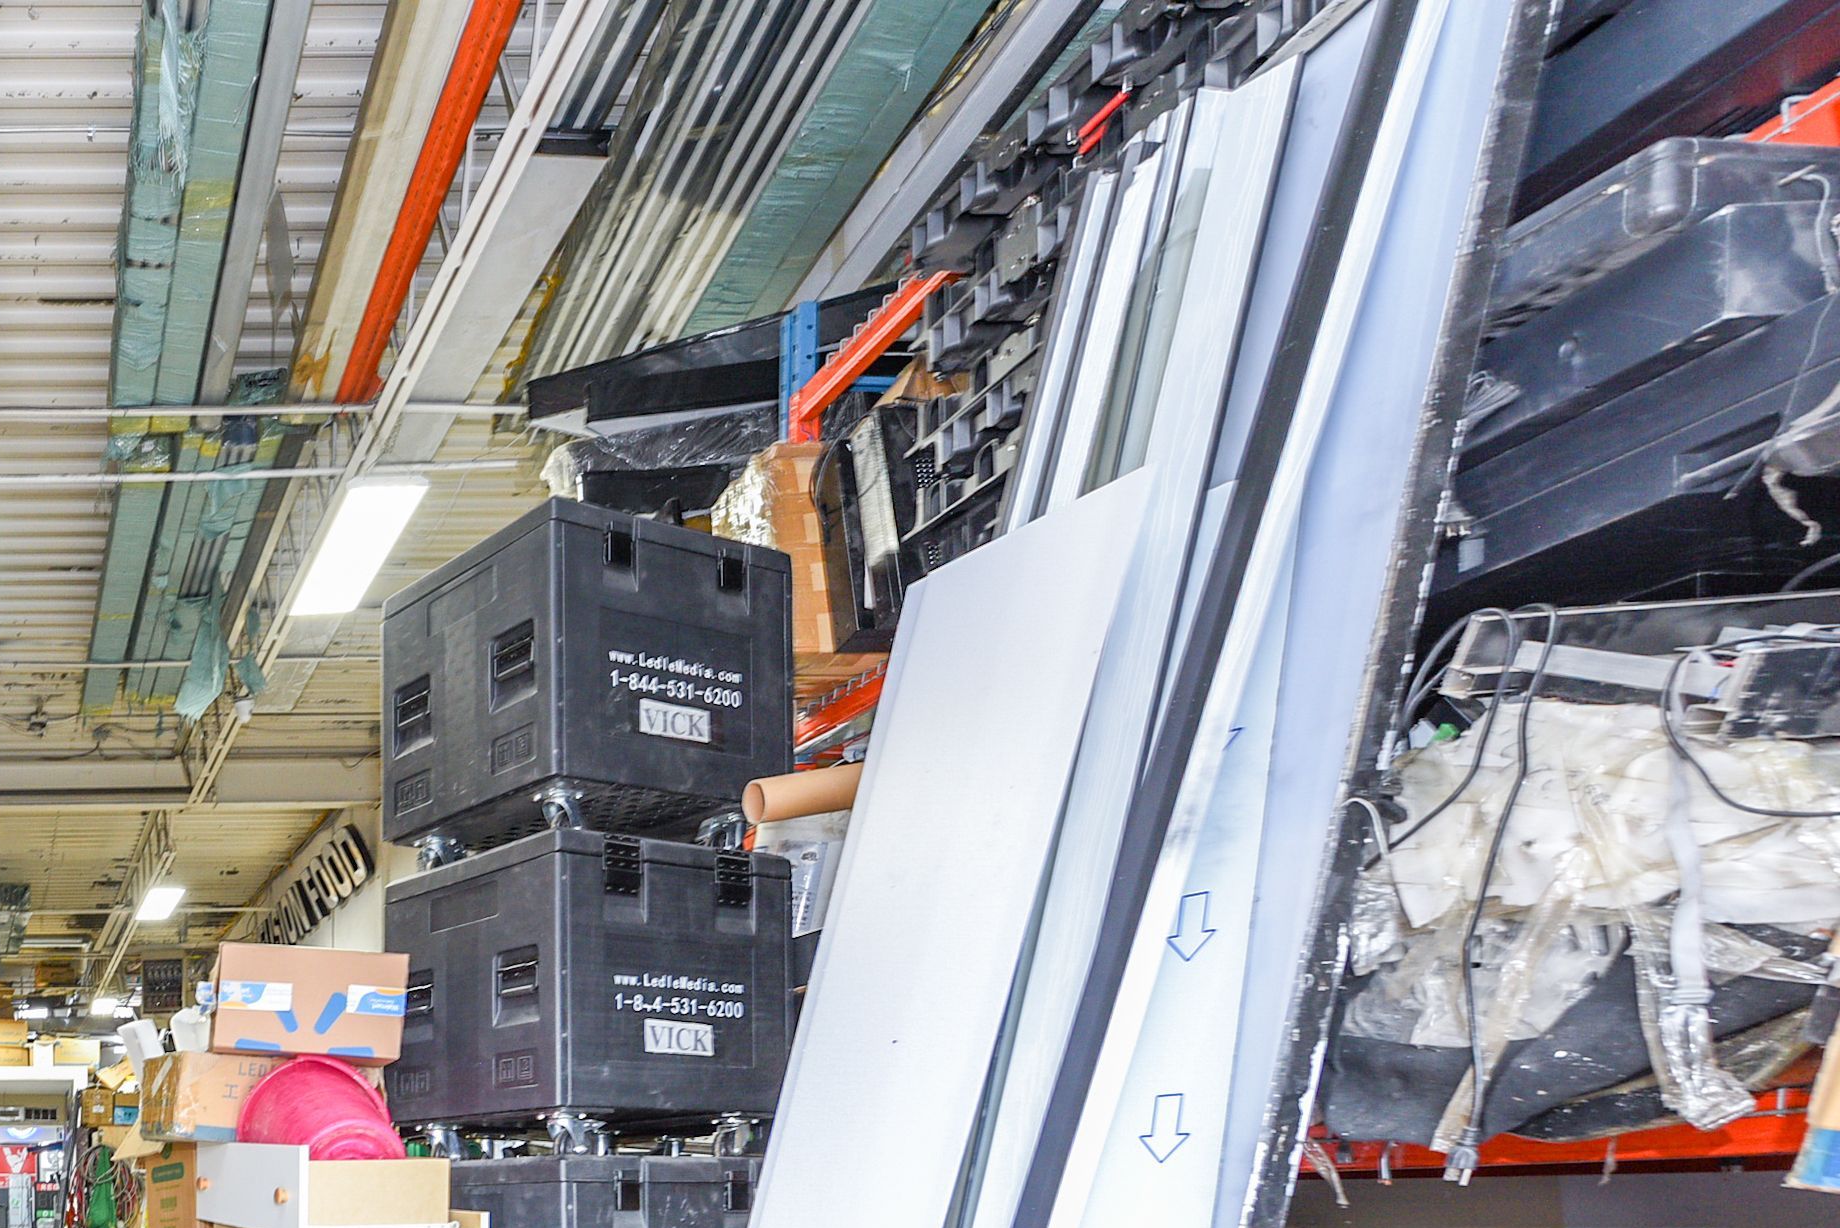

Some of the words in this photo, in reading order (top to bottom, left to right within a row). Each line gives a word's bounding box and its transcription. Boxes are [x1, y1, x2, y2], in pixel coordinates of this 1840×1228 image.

[610, 669, 743, 708] 1-844-531-6200
[644, 708, 706, 737] VICK
[298, 823, 374, 920] FOOD
[649, 1025, 710, 1052] VICK
[238, 1062, 268, 1078] LED
